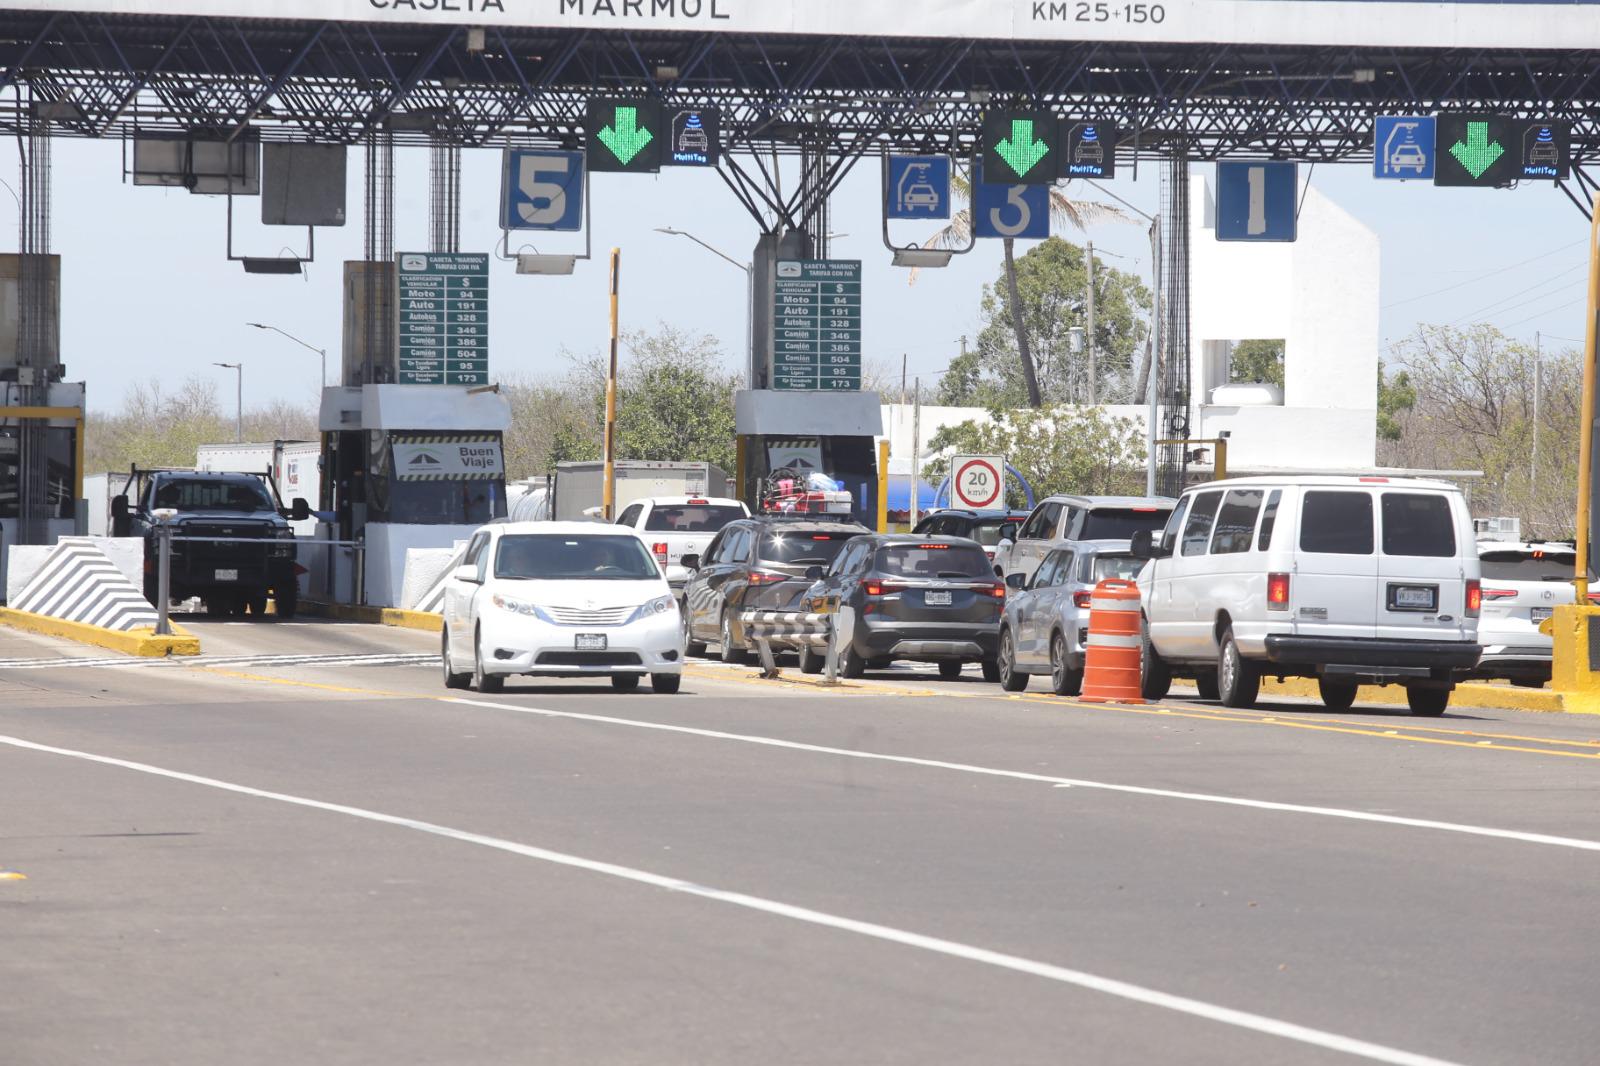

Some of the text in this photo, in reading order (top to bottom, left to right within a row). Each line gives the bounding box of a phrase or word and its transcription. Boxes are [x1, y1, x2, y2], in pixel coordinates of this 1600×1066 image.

[559, 0, 730, 19] MARMOL
[1032, 2, 1165, 23] KM 25+150
[673, 153, 707, 163] MultiTag
[1070, 165, 1102, 174] MultiTag
[1524, 166, 1557, 176] MultiTag
[517, 155, 568, 224] 5
[1248, 167, 1266, 235] 1
[990, 184, 1031, 236] 3
[408, 290, 435, 298] Moto
[409, 300, 434, 309] Auto
[784, 306, 809, 314] Auto
[830, 332, 850, 340] 346
[830, 344, 850, 352] 386
[457, 350, 477, 358] 504
[831, 380, 850, 388] 173
[459, 447, 494, 456] Buen
[461, 457, 494, 468] Viaje
[969, 472, 987, 486] 20
[967, 488, 988, 496] km/h
